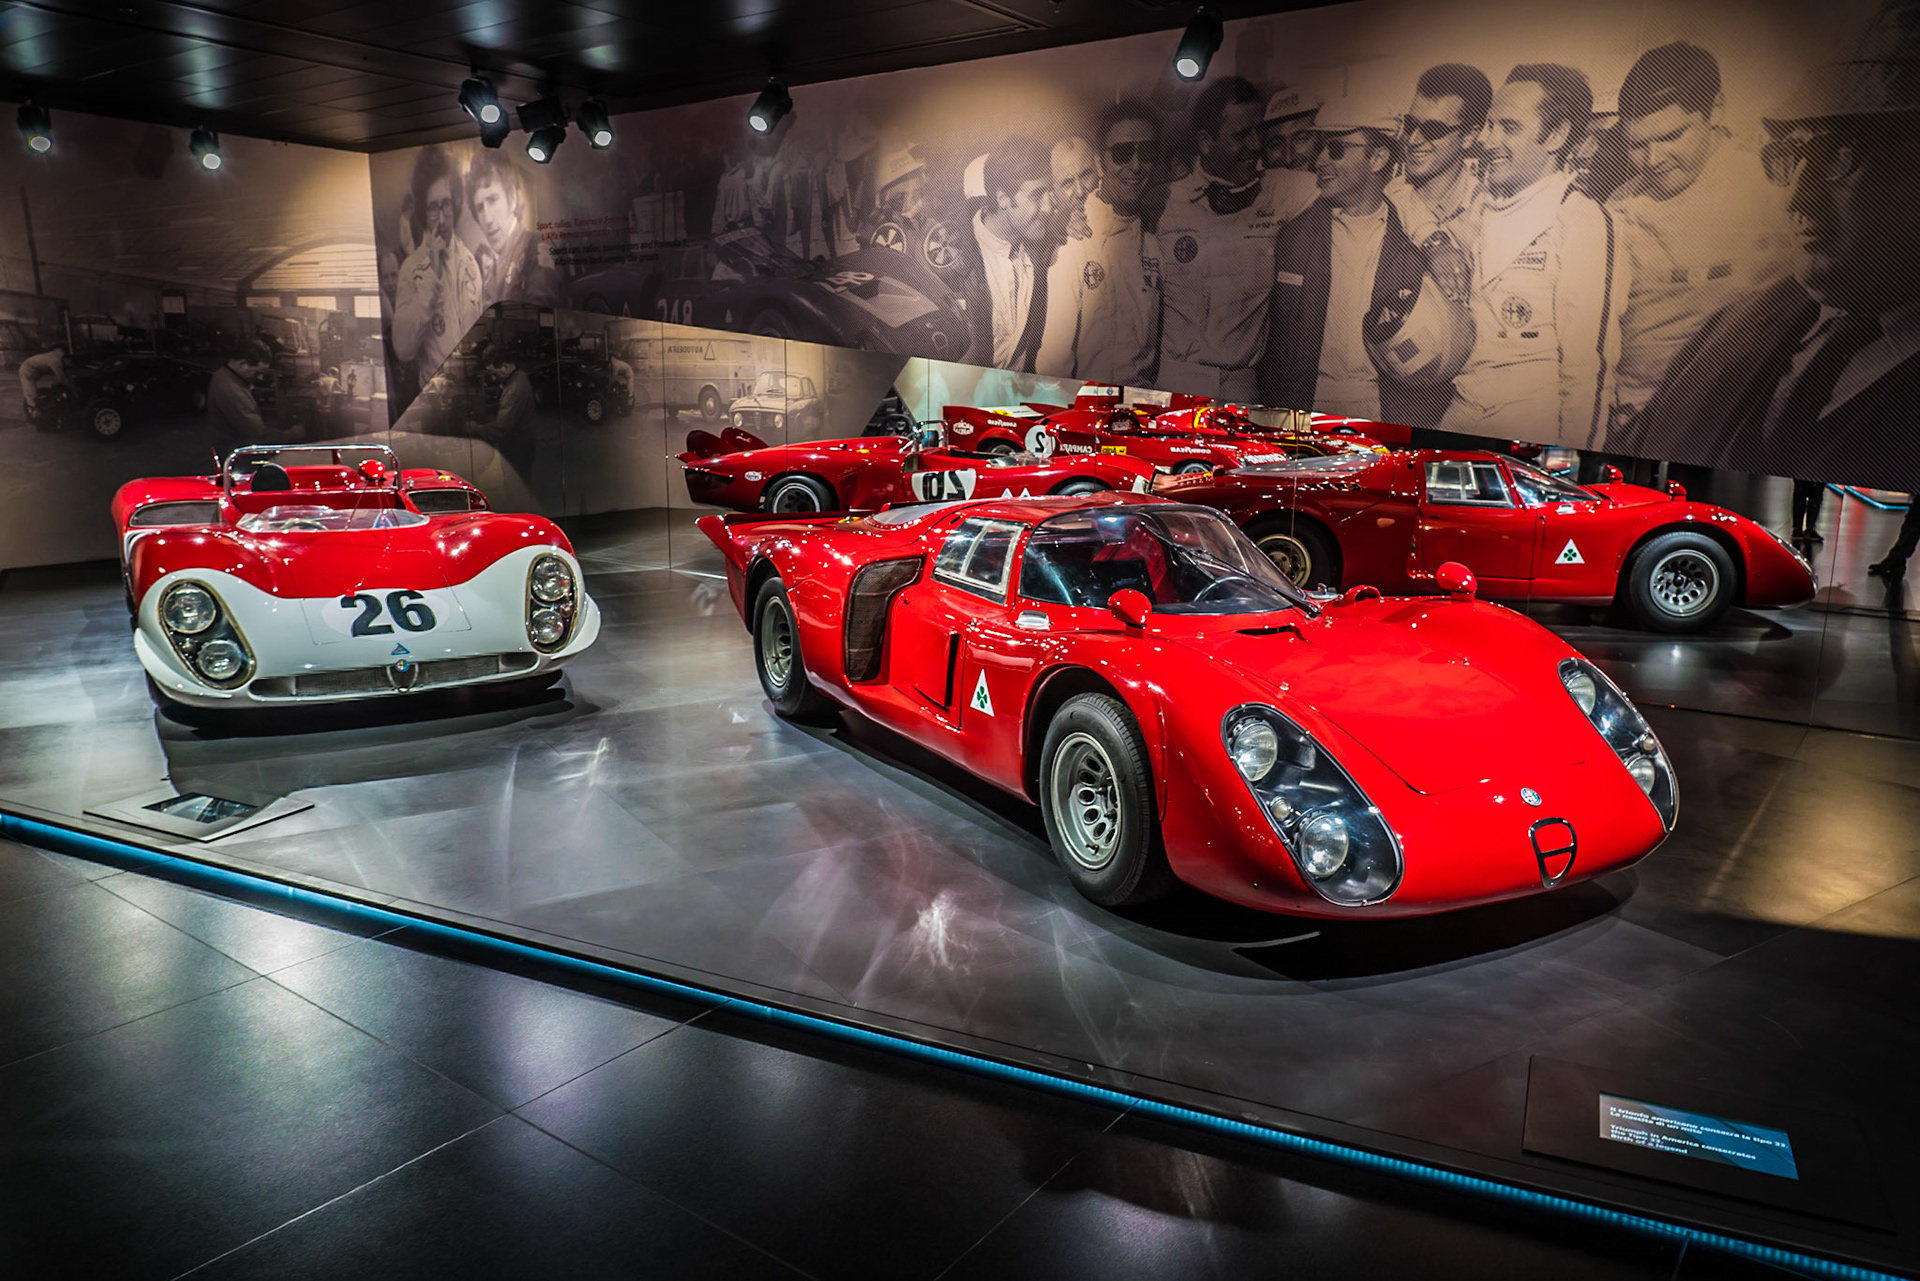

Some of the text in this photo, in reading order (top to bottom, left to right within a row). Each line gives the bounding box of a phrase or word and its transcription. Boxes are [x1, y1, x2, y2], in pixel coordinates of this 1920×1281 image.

[340, 589, 437, 637] 26
[1618, 1108, 1649, 1119] trionfo
[1651, 1116, 1698, 1129] americano
[1699, 1126, 1740, 1138] consacra
[1753, 1137, 1772, 1145] tipo
[1622, 1114, 1654, 1124] nascita
[1680, 1127, 1703, 1135] mito
[1628, 1132, 1648, 1141] Tipo
[1610, 1124, 1648, 1136] Triumph
[1661, 1135, 1699, 1147] America
[1701, 1144, 1756, 1160] consecrates
[1610, 1133, 1634, 1143] Birth
[1656, 1143, 1688, 1154] legend
